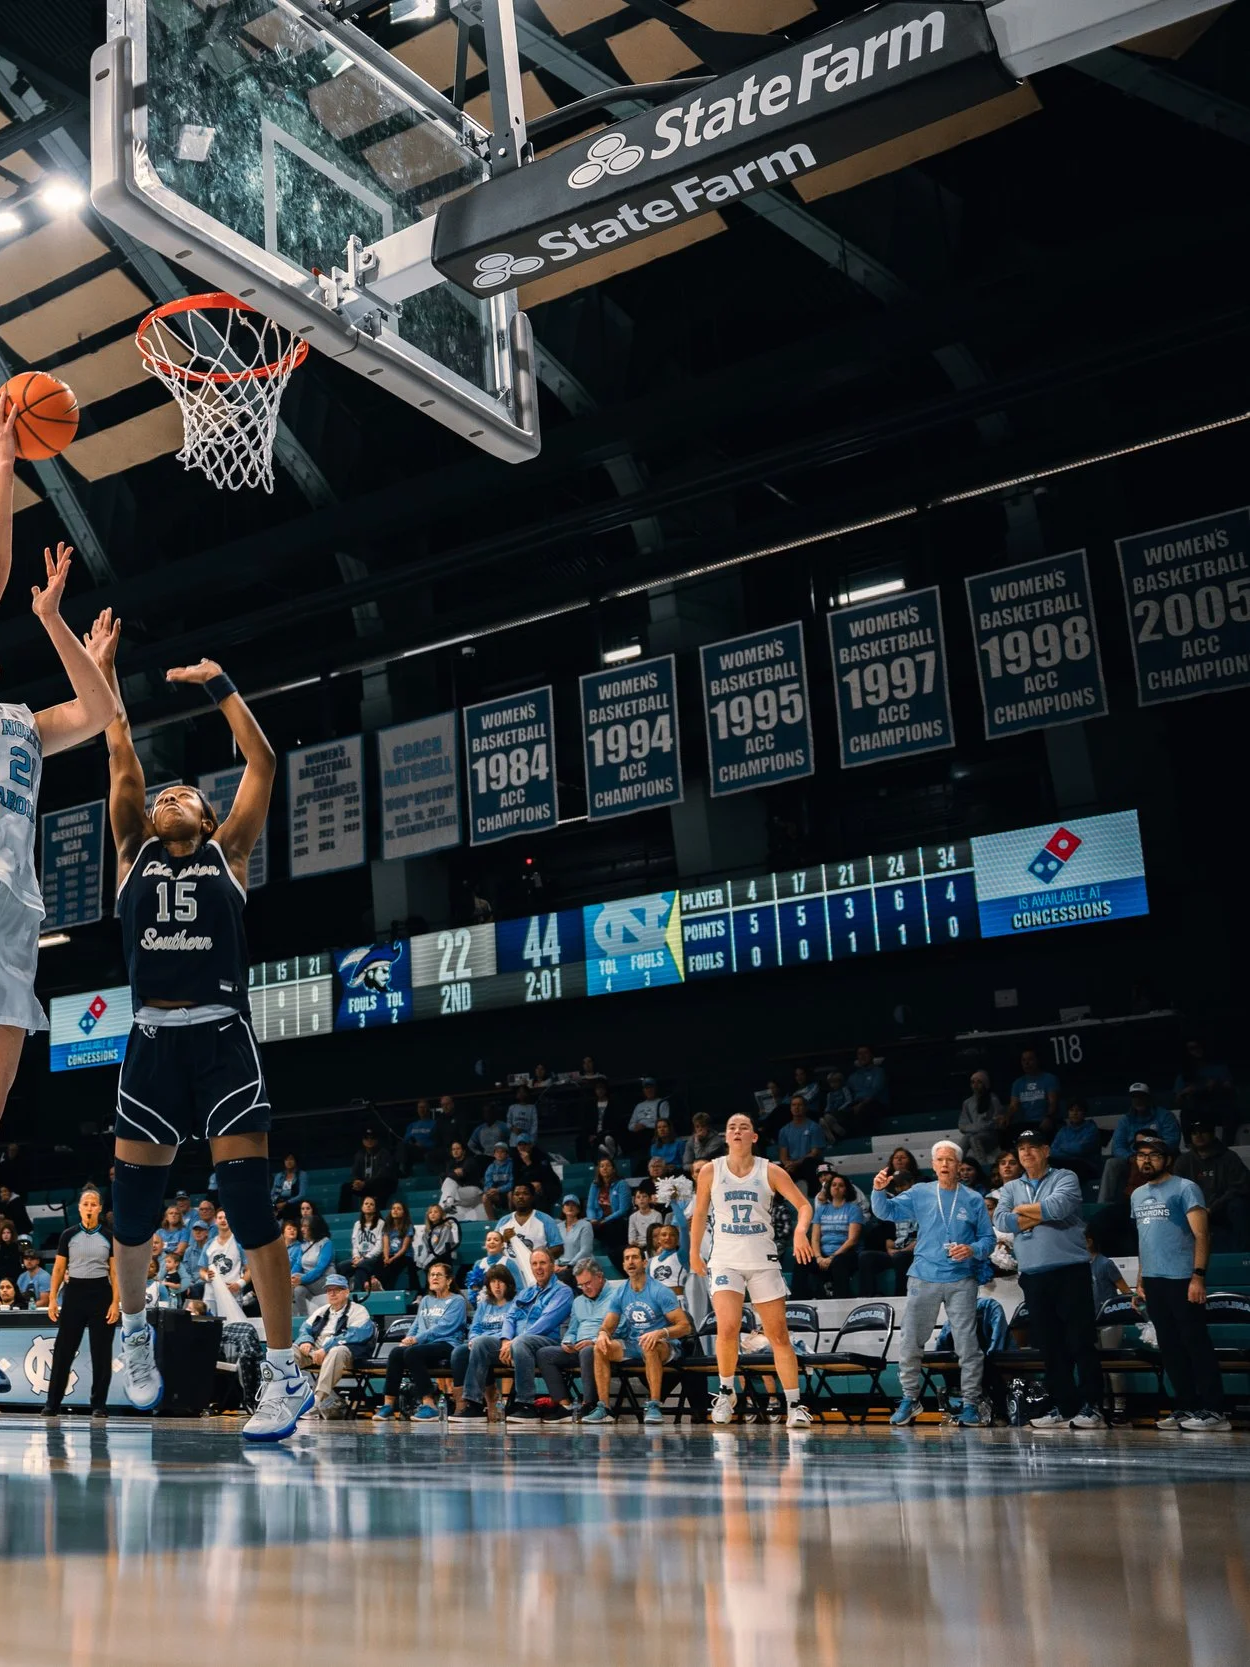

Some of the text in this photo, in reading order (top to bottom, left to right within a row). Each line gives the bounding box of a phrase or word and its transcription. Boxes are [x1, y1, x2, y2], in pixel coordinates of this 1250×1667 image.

[1143, 528, 1230, 567] WOMEN'S
[990, 568, 1066, 603] WOMEN'S
[1132, 551, 1249, 596] BASKETBALL
[849, 604, 920, 638] WOMEN'S
[979, 592, 1083, 631] BASKETBALL
[1133, 577, 1250, 645] 2005
[719, 638, 785, 671] WOMEN'S
[839, 627, 935, 665] BASKETBALL
[979, 615, 1092, 679] 1998
[1181, 634, 1222, 660] ACC
[710, 661, 798, 697] BASKETBALL
[841, 650, 936, 709] 1997
[1023, 671, 1059, 695] ACC
[1147, 651, 1250, 691] CHAMPION
[598, 672, 658, 701] WOMEN'S
[481, 703, 537, 731] WOMEN'S
[588, 693, 670, 725] BASKETBALL
[710, 683, 804, 740] 1995
[877, 703, 911, 725] ACC
[993, 687, 1096, 725] CHAMPIONS
[471, 723, 547, 753] BASKETBALL
[588, 714, 674, 767] 1994
[745, 733, 775, 756] ACC
[849, 719, 943, 755] CHAMPIONS
[298, 757, 352, 780] BASKETBALL
[471, 743, 550, 795] 1984
[619, 761, 648, 782] ACC
[718, 749, 805, 783] CHAMPIONS
[296, 781, 358, 807] APPEARANCES
[500, 789, 526, 809] ACC
[594, 777, 675, 809] CHAMPIONS
[51, 823, 94, 843] BASKETBALL
[477, 803, 551, 834] CHAMPIONS
[681, 846, 956, 911] PLAYER 4 17 21 24 34
[156, 882, 198, 922] 15
[683, 881, 956, 942] POINTS 5 5 3 6 4
[1018, 886, 1102, 910] IS AVAILABLE AT
[1012, 900, 1113, 929] CONCESSIONS
[140, 927, 213, 951] Southern
[437, 912, 561, 983] 22 44
[688, 916, 959, 973] FOULS 0 0 1 1 0
[276, 956, 321, 981] 15 21
[599, 951, 664, 976] TOL FOULS
[440, 968, 562, 1015] 2ND 2:01
[605, 971, 651, 993] 4 3
[348, 991, 404, 1014] FOULS TOL
[279, 1018, 285, 1036] 1
[359, 1009, 398, 1028] 3 2
[67, 1048, 119, 1067] CONCESSIONS
[1050, 1034, 1083, 1065] 118
[724, 1190, 758, 1203] NORTH
[730, 1204, 753, 1223] 17
[1135, 1208, 1171, 1217] AMPIONS
[720, 1222, 768, 1235] CAROLINA
[786, 1311, 811, 1322] OLINA
[849, 1310, 885, 1322] CAROLINA
[1104, 1301, 1133, 1314] CARO
